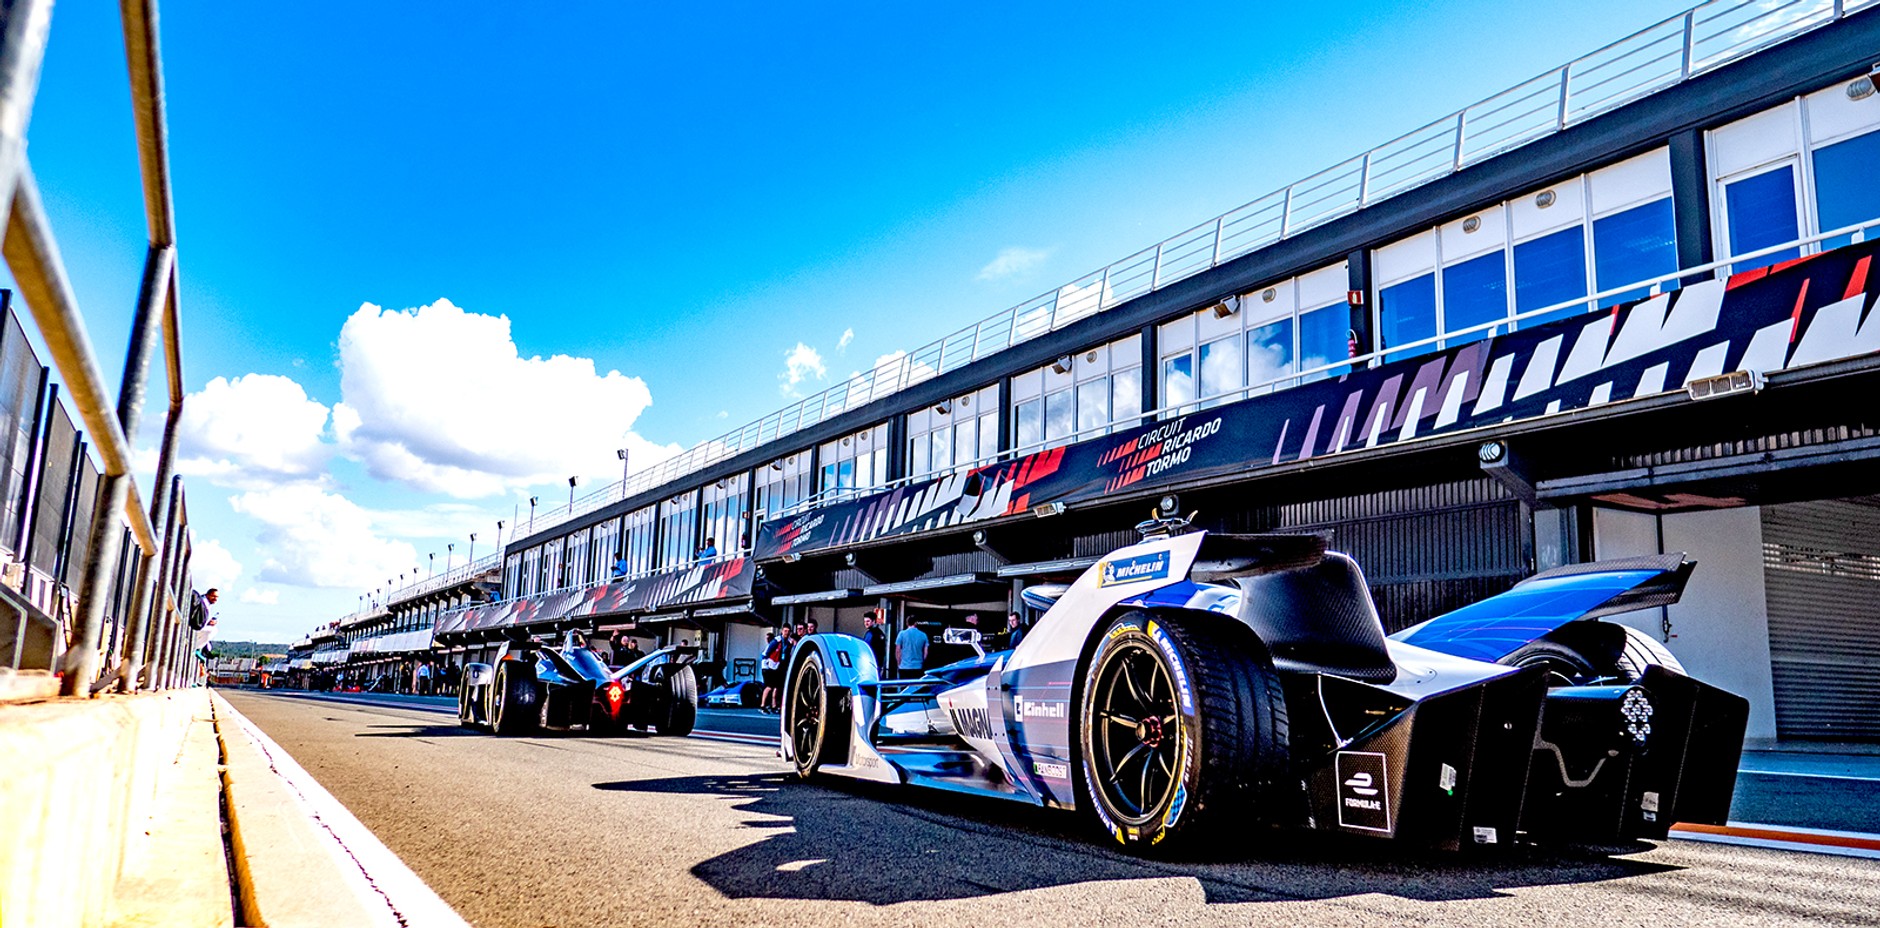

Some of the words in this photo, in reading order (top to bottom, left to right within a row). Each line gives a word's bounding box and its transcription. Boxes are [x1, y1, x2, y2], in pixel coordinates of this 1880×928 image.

[1138, 417, 1186, 449] CIRCUIT
[1161, 417, 1222, 455] RICARDO
[1146, 446, 1191, 477] TORMO
[800, 514, 825, 534] RICARDO
[791, 530, 811, 548] TORMO
[1116, 560, 1164, 578] MICHELIN
[1160, 637, 1192, 708] MICHELIN
[1023, 702, 1064, 718] Einhell
